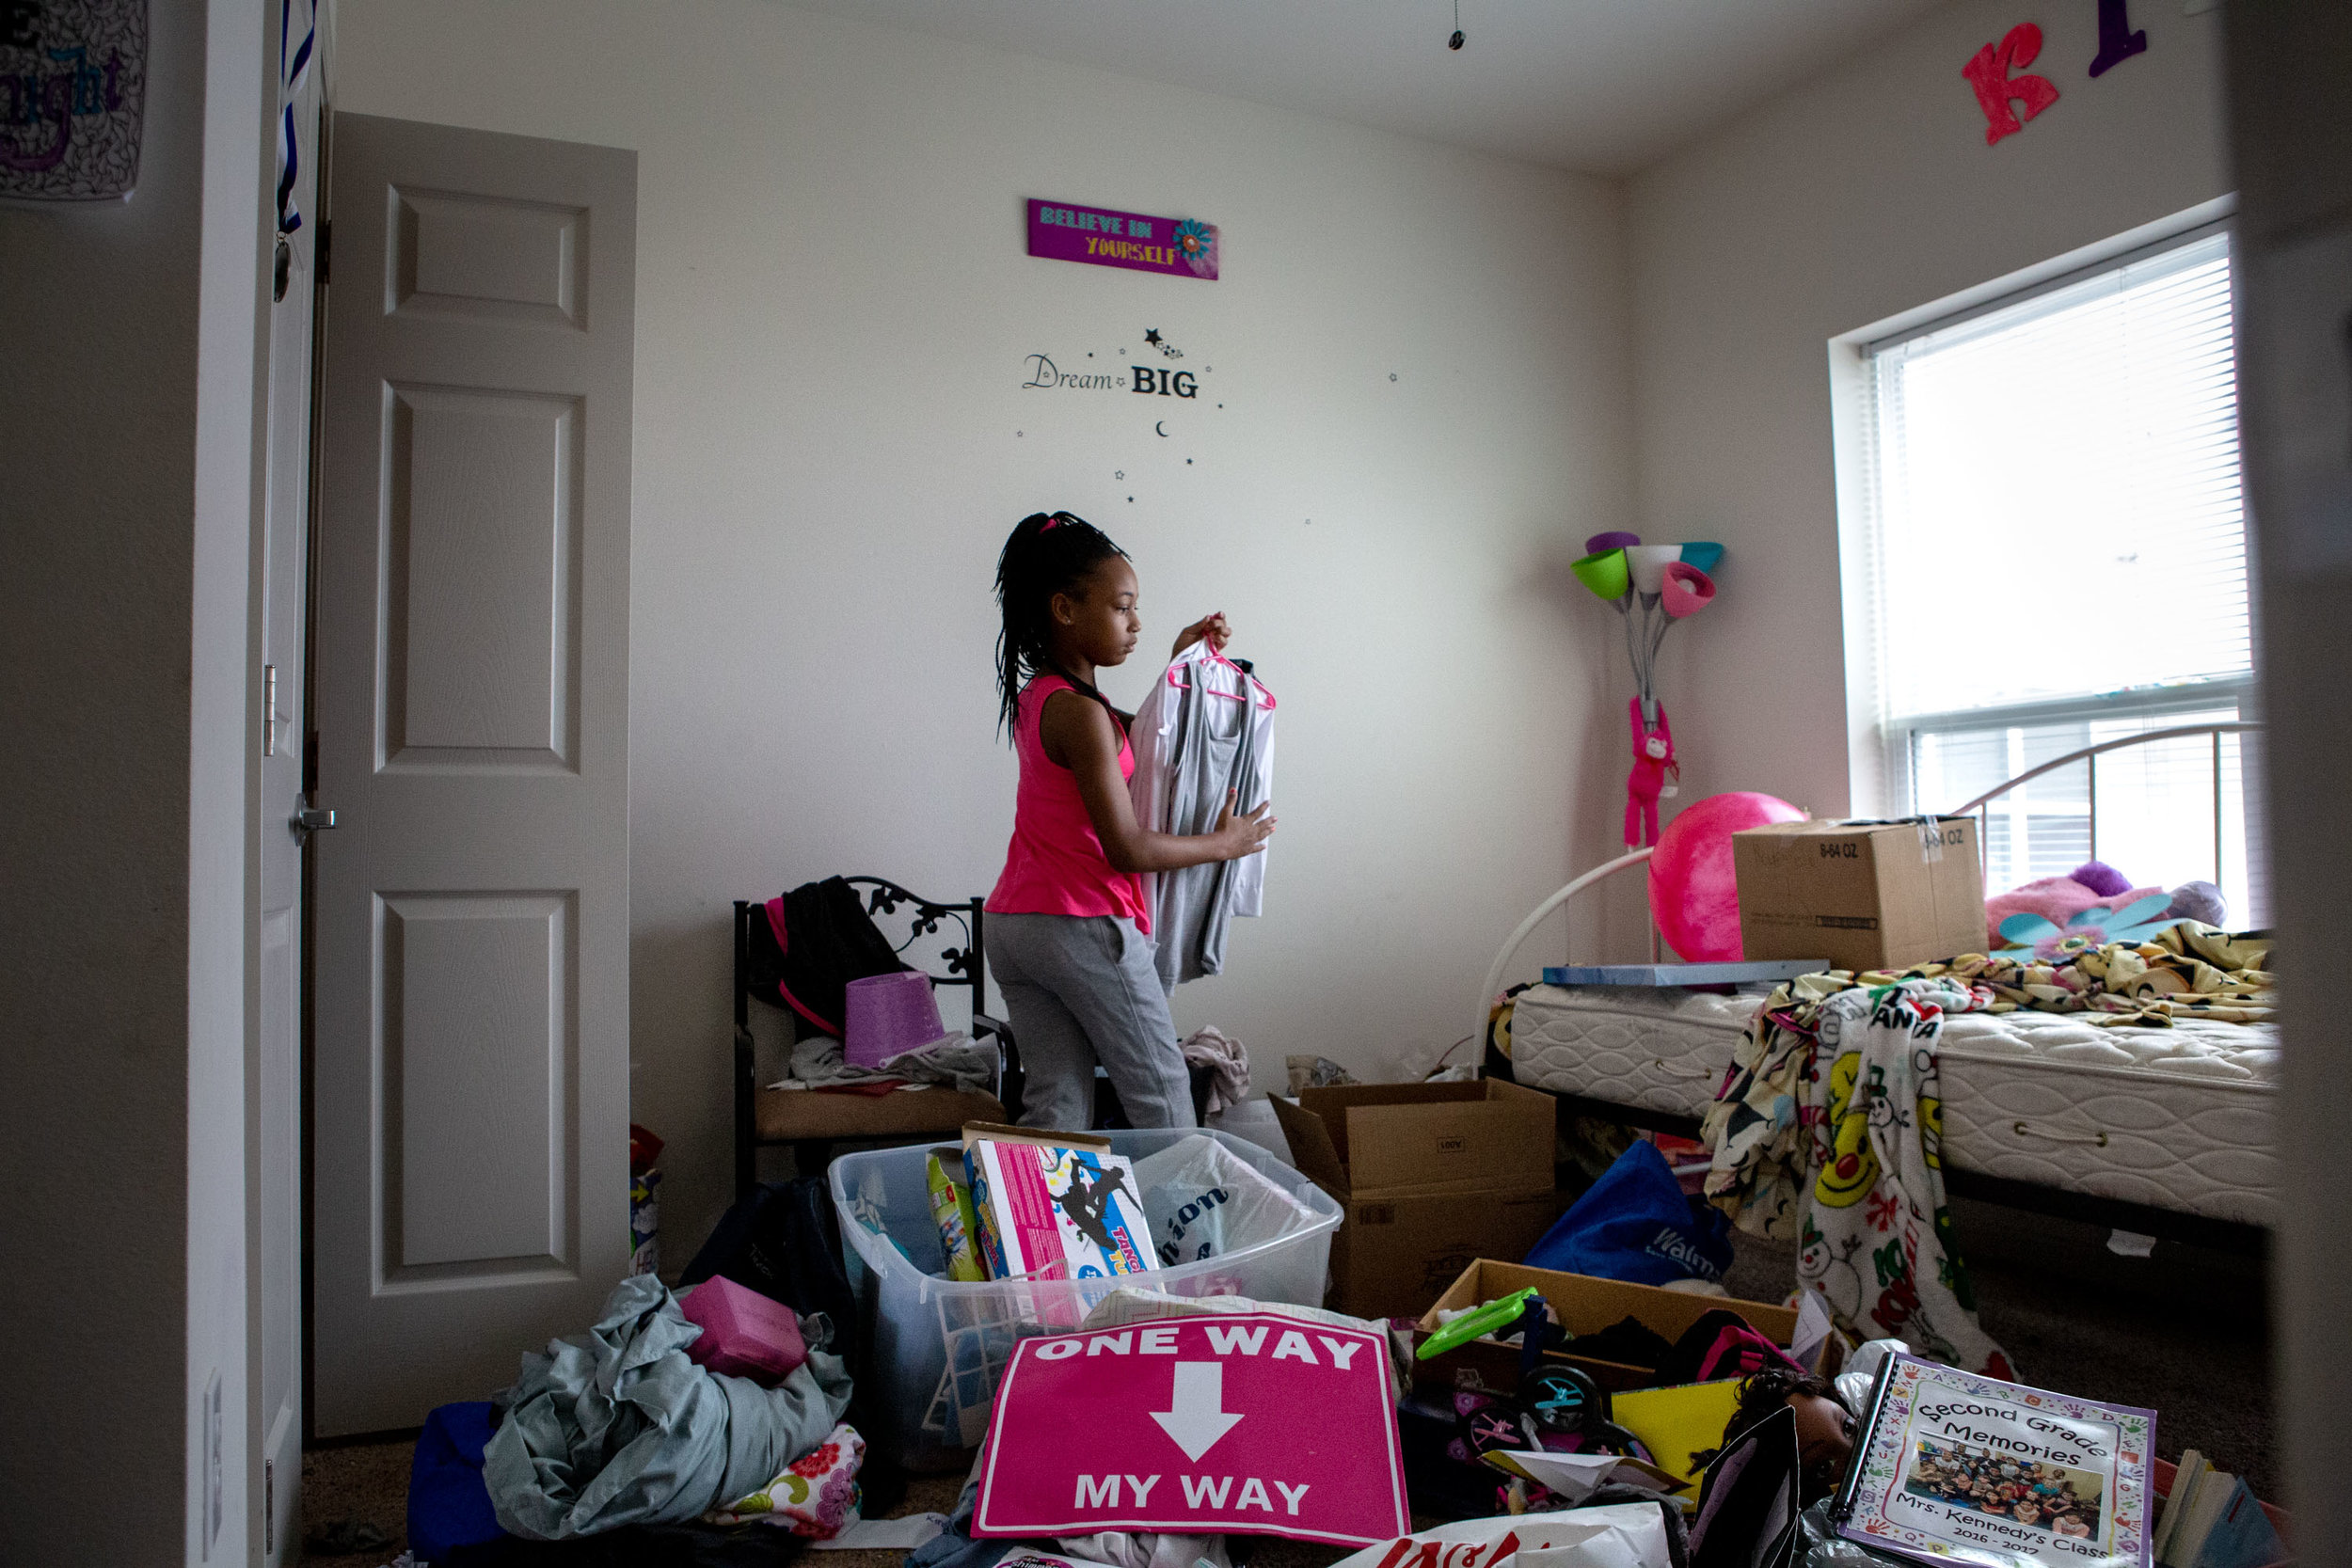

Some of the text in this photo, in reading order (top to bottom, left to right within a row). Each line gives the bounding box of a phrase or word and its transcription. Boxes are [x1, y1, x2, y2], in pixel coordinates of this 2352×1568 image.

[1040, 206, 1152, 239] BELIEVE IN
[1086, 236, 1177, 266] YOURSELF
[1022, 353, 1199, 399] Dream BIG
[1820, 843, 1840, 858] 8-64
[1843, 843, 1858, 858] OZ
[1950, 830, 1963, 845] OZ
[1035, 1325, 1362, 1370] ONE WAY
[1918, 1403, 2107, 1457] Second Grade
[1944, 1422, 2081, 1465] Memories
[1074, 1474, 1311, 1516] MY WAY
[1896, 1492, 2109, 1560] Mrs. Kennedy's Class
[1953, 1527, 1988, 1544] 2016
[2002, 1541, 2039, 1555] 2017
